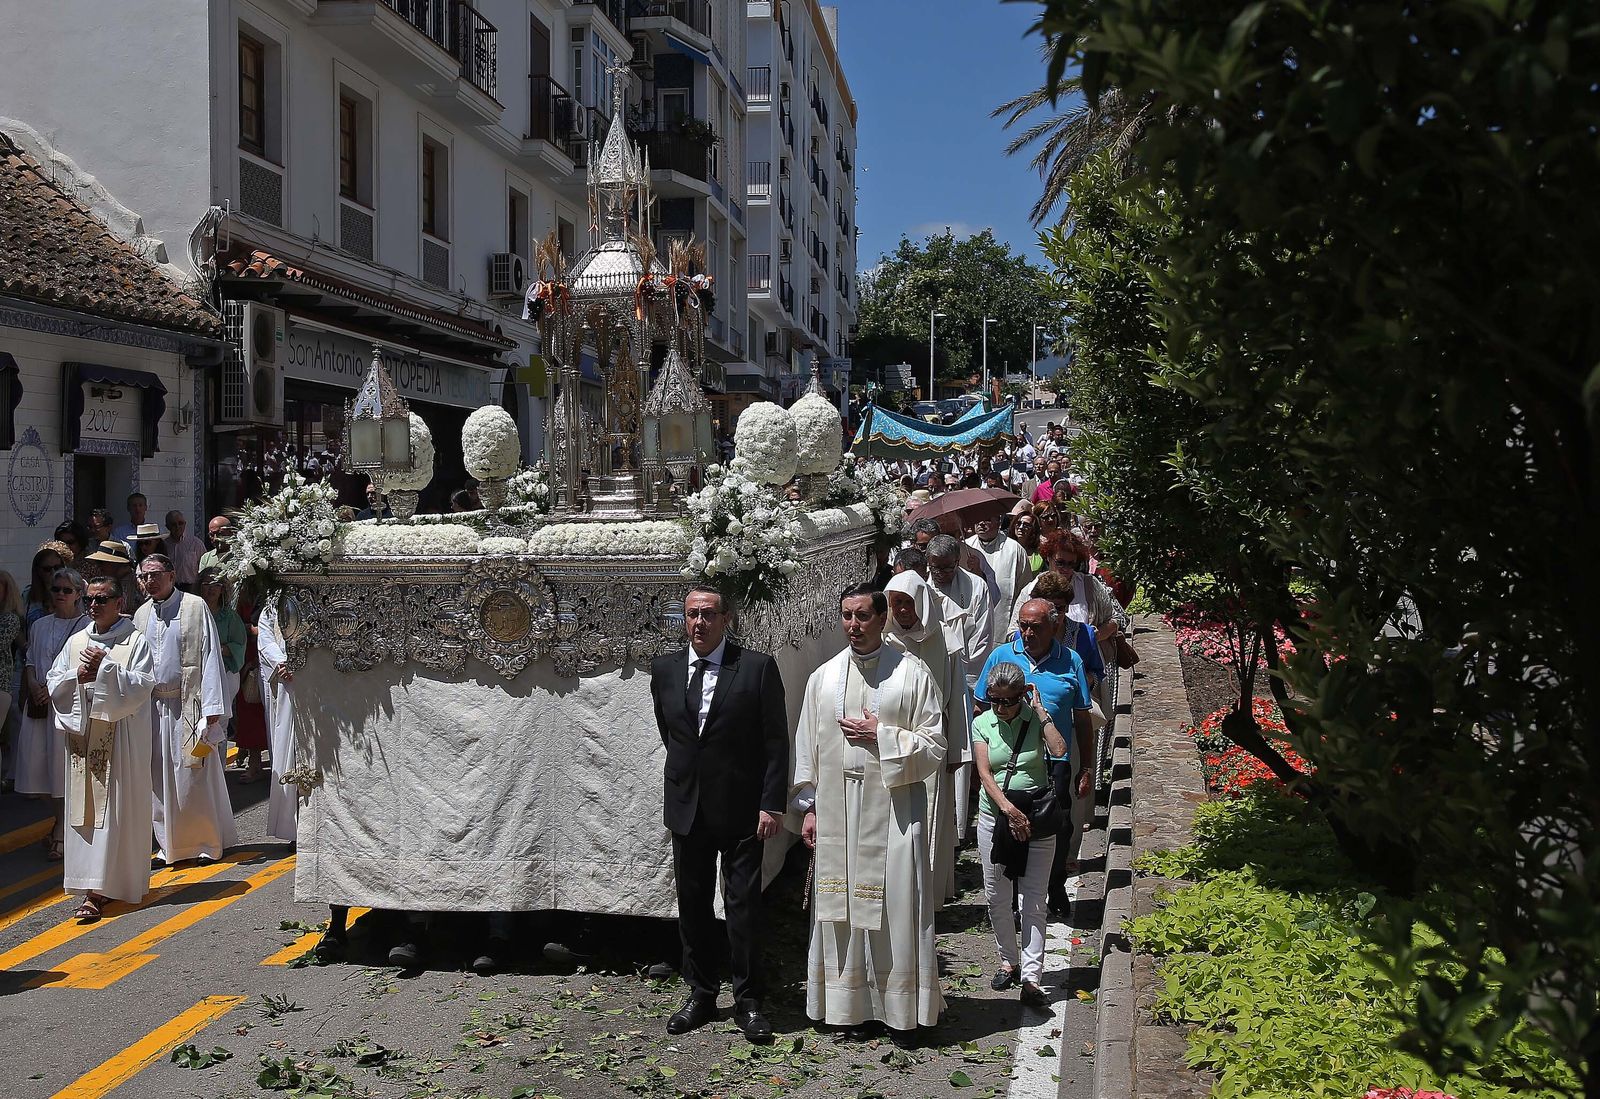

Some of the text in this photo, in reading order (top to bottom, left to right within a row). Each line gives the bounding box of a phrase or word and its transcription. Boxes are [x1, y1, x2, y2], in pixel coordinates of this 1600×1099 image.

[288, 333, 363, 377] SanAntonio
[379, 354, 442, 395] RTOPEDIA
[20, 456, 40, 468] CASA
[12, 475, 48, 492] CASTRO
